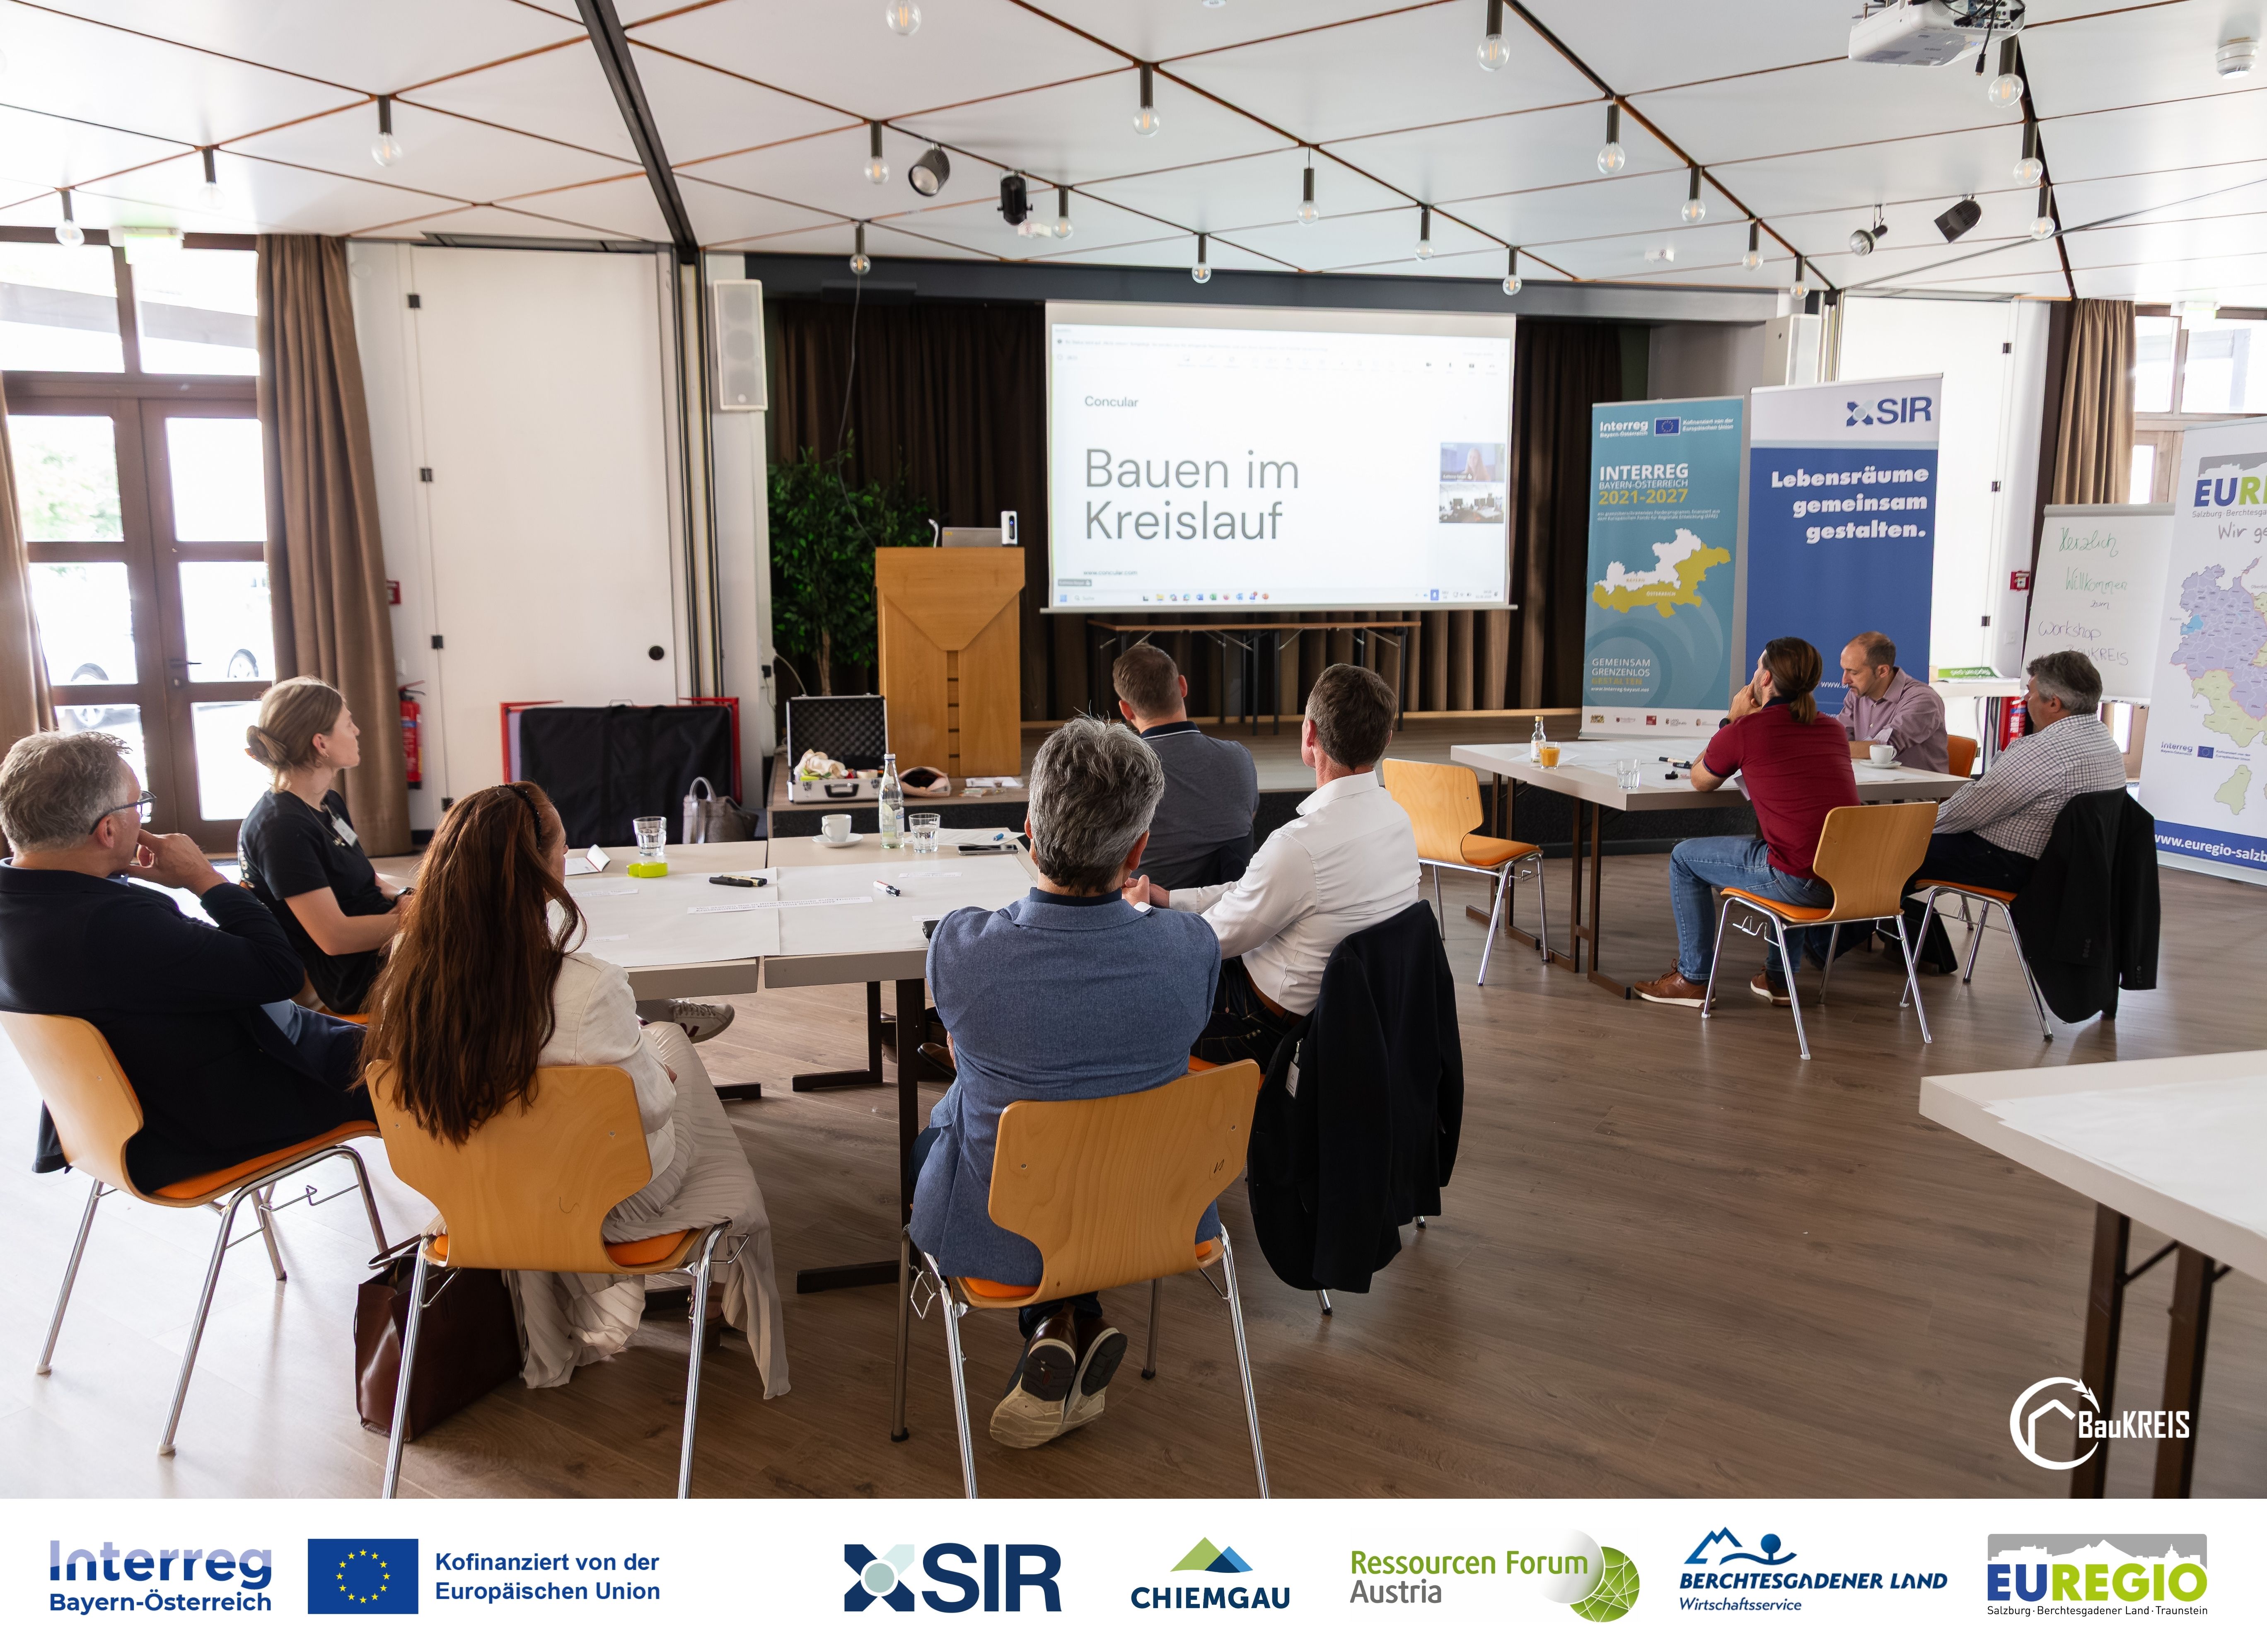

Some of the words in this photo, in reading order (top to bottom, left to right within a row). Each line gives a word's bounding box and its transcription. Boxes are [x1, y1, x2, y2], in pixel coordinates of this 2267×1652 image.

[1084, 395, 1139, 408] Concular
[1877, 396, 1933, 425] SIR
[1600, 420, 1648, 432] Interreg
[1085, 448, 1230, 489] Bauen
[1247, 449, 1300, 489] im
[1600, 463, 1689, 481] INTERREG
[1772, 465, 1929, 488] Lebensräume
[1599, 479, 1688, 490] BAYERN-ÖSTERREICH
[2193, 476, 2267, 508] EUR
[1598, 488, 1689, 505] 2021-2027
[1793, 493, 1928, 519] gemeinsam
[1085, 501, 1283, 540] Kreislauf
[2218, 521, 2247, 540] Wir
[1806, 519, 1926, 544] gestalten.
[2059, 527, 2119, 558] Herzlich
[2065, 566, 2128, 594] Willkommen
[2038, 621, 2102, 641] Workshop
[1591, 668, 1651, 677] GRENZENLOS
[1592, 658, 1651, 667] GEMEINSAM
[2161, 741, 2193, 753] Interreg
